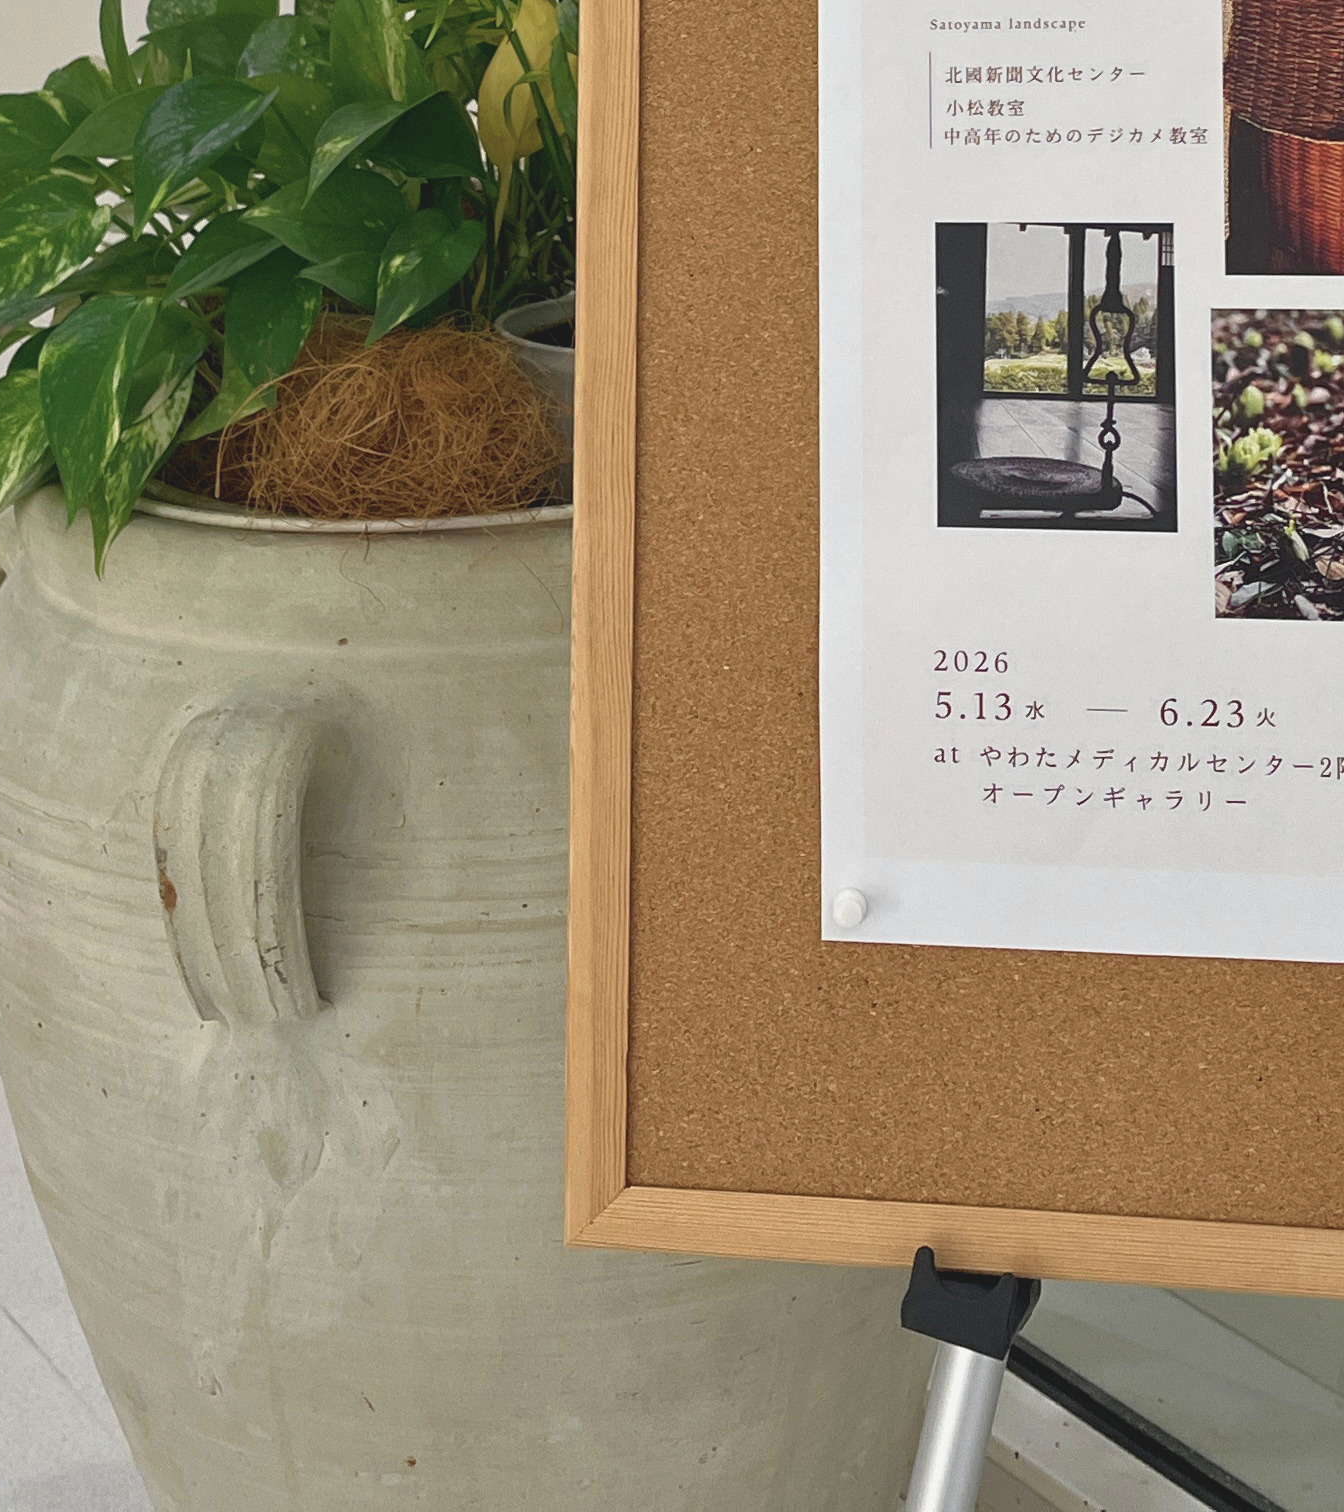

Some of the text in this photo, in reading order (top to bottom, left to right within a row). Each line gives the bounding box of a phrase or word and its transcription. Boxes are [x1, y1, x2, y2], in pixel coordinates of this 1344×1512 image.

[930, 18, 1085, 32] Satoyama landscape
[945, 66, 1145, 84] 北國新聞文化センター
[947, 99, 1024, 116] 小松教室
[945, 127, 1208, 145] 中高年のためのデジカメ教室
[934, 650, 1008, 673] 2026
[934, 747, 959, 763] at
[983, 784, 1246, 811] オープンギャラリー
